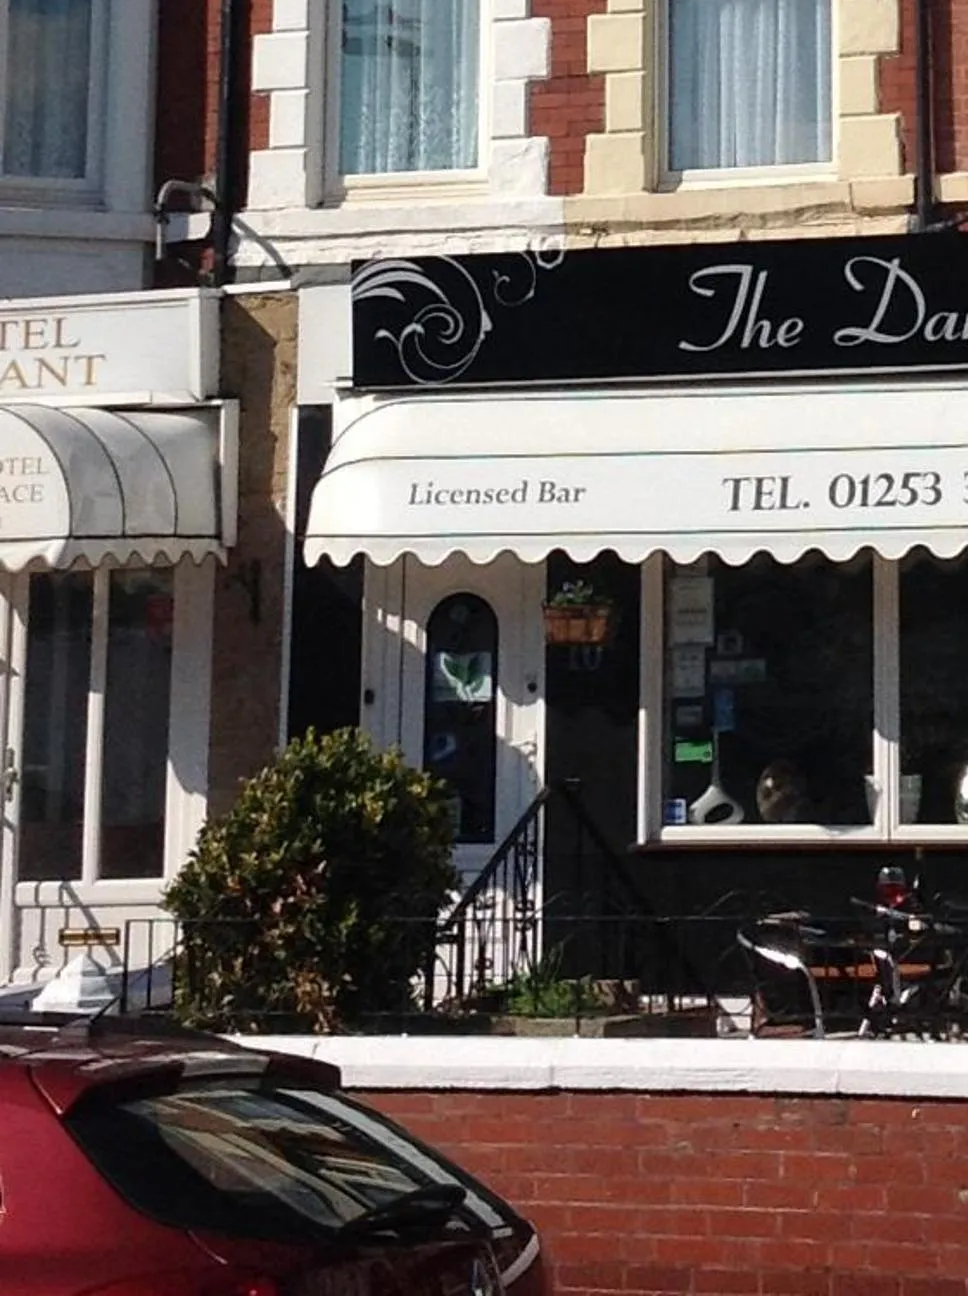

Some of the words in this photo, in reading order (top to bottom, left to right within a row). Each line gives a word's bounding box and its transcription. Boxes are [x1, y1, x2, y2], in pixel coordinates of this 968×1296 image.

[678, 264, 804, 352] The
[0, 354, 106, 389] ANT
[408, 480, 528, 506] Licensed
[538, 480, 586, 504] Bar
[722, 475, 810, 513] TEL.
[828, 471, 943, 509] 01253
